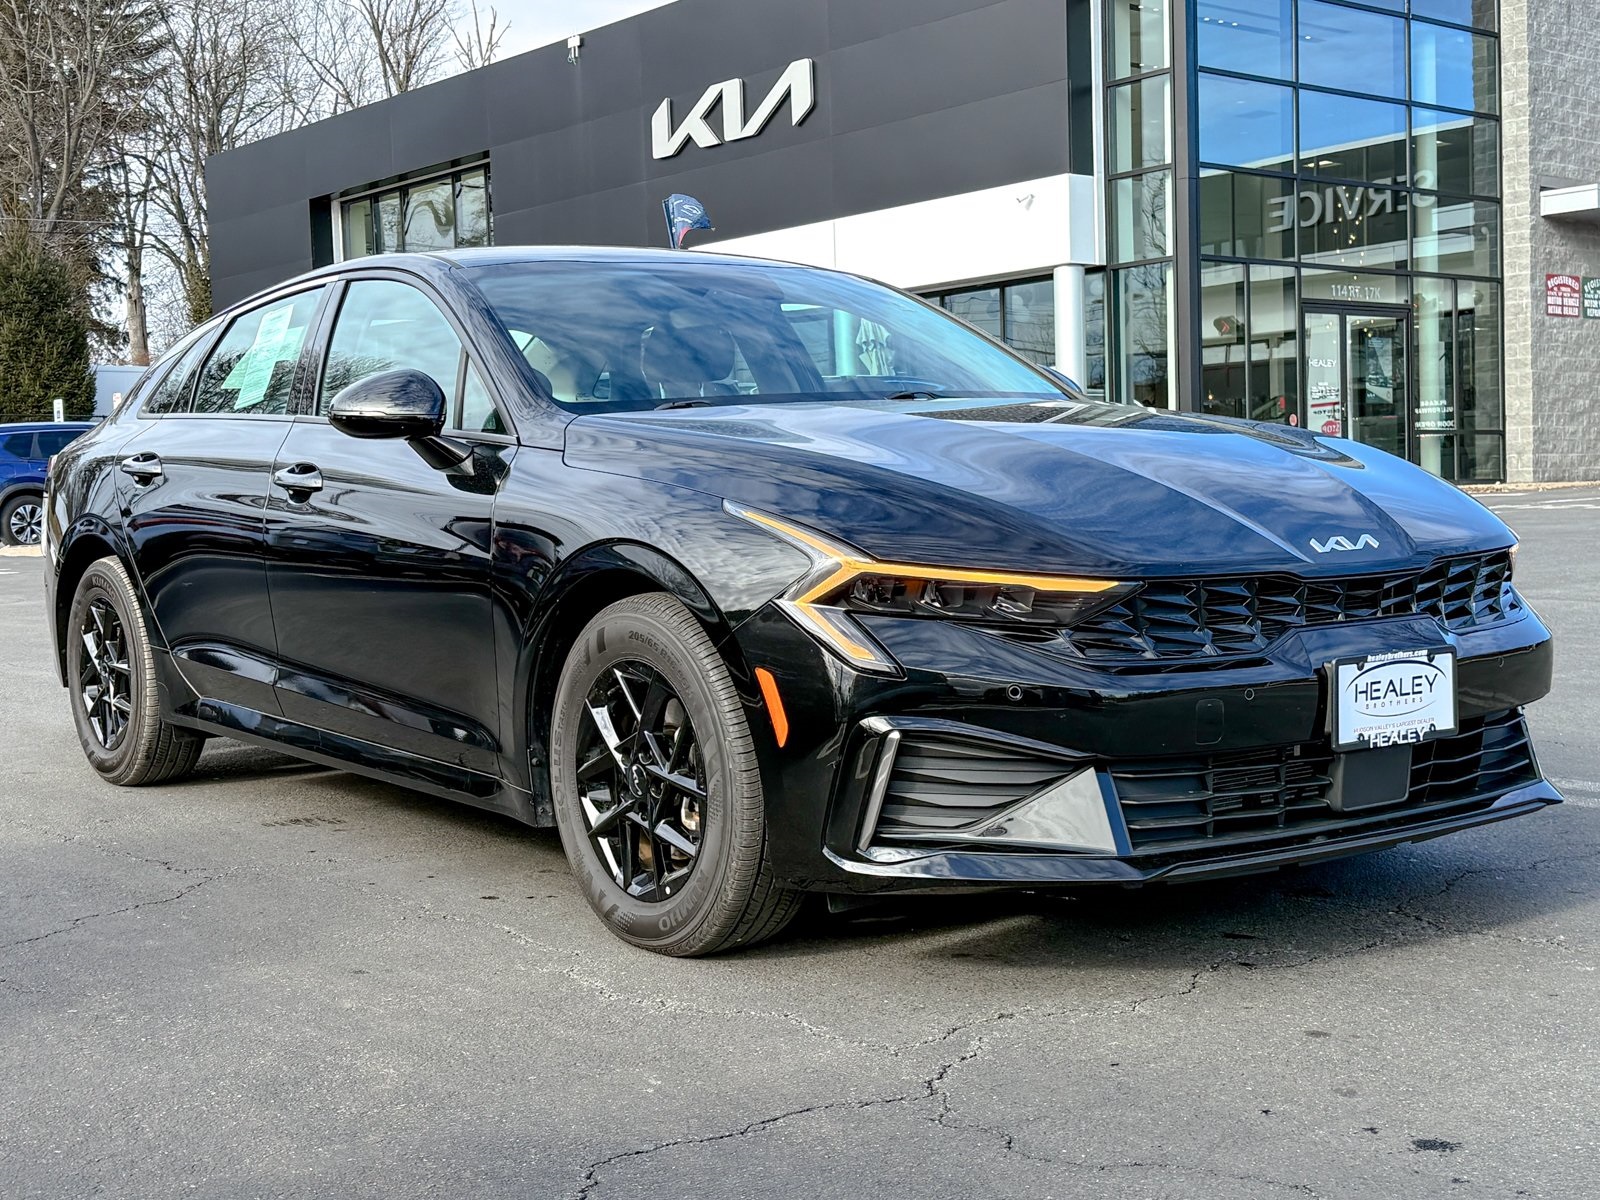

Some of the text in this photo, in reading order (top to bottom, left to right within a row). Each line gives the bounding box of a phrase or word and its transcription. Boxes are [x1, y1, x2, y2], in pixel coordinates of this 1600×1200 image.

[651, 58, 814, 159] KIA
[1365, 286, 1381, 300] 17K
[1309, 358, 1337, 368] HEALEY
[1309, 533, 1380, 553] KIA
[1367, 650, 1428, 662] healeybrothers.com
[1354, 673, 1438, 703] HEALEY
[1365, 697, 1423, 710] BROTHERS
[1396, 720, 1416, 728] LARGEST
[1369, 727, 1425, 748] HEALEY
